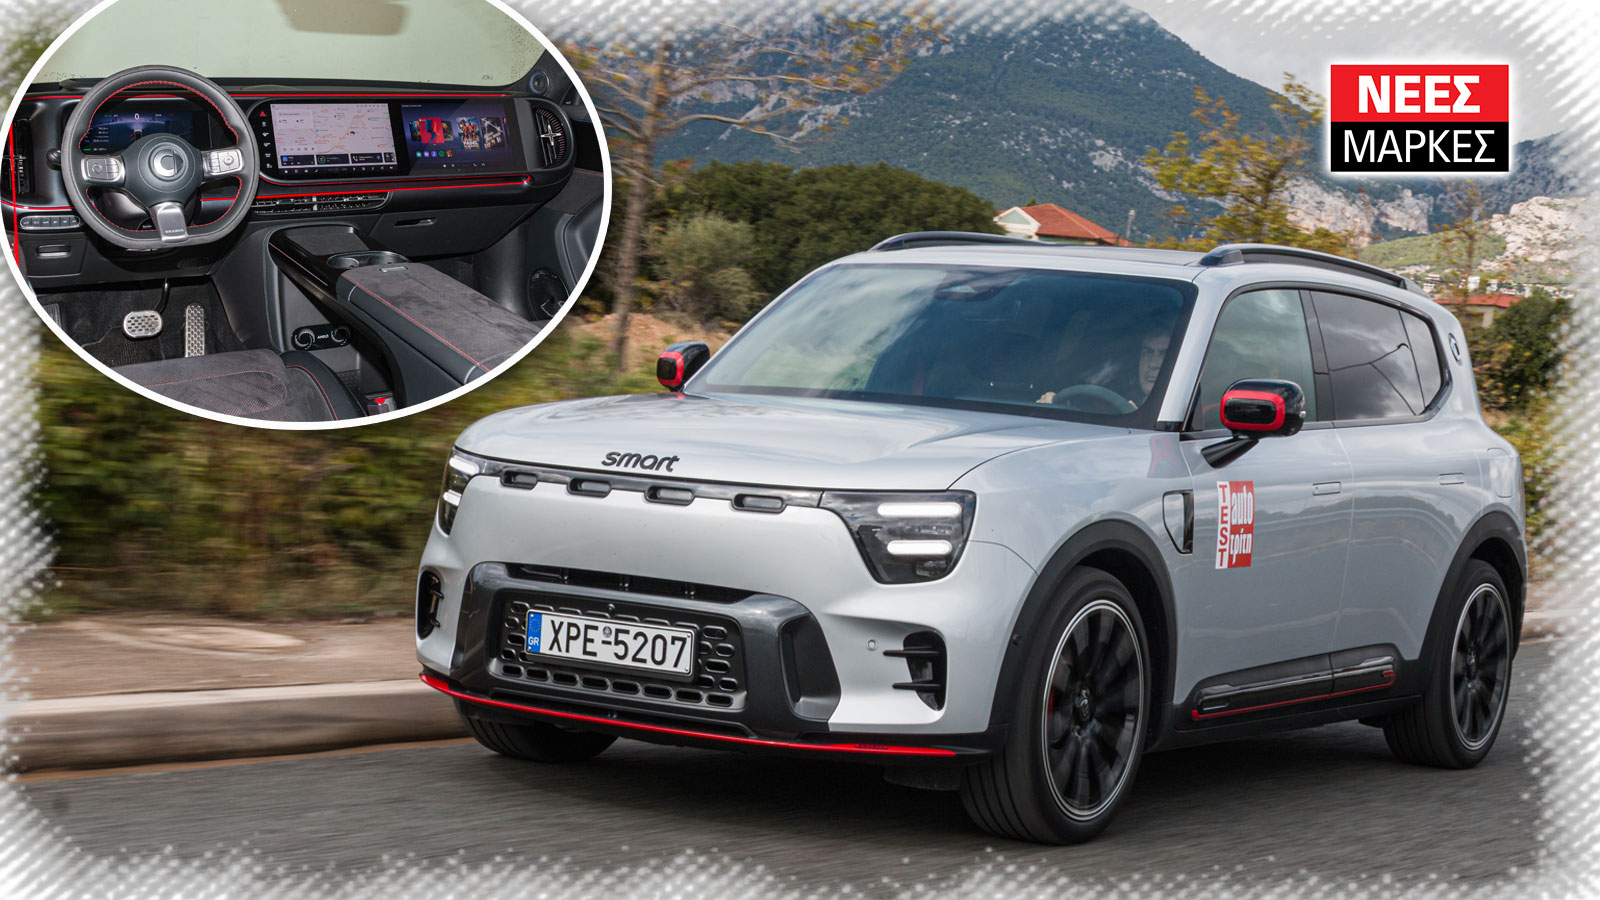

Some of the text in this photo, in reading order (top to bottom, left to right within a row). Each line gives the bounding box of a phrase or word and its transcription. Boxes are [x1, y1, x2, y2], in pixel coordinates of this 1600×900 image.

[601, 451, 680, 473] smart
[1231, 484, 1254, 526] auto
[1218, 484, 1229, 568] TEST
[1230, 527, 1253, 566] τρίτη
[528, 636, 540, 647] GR
[548, 619, 688, 669] XPE-5207
